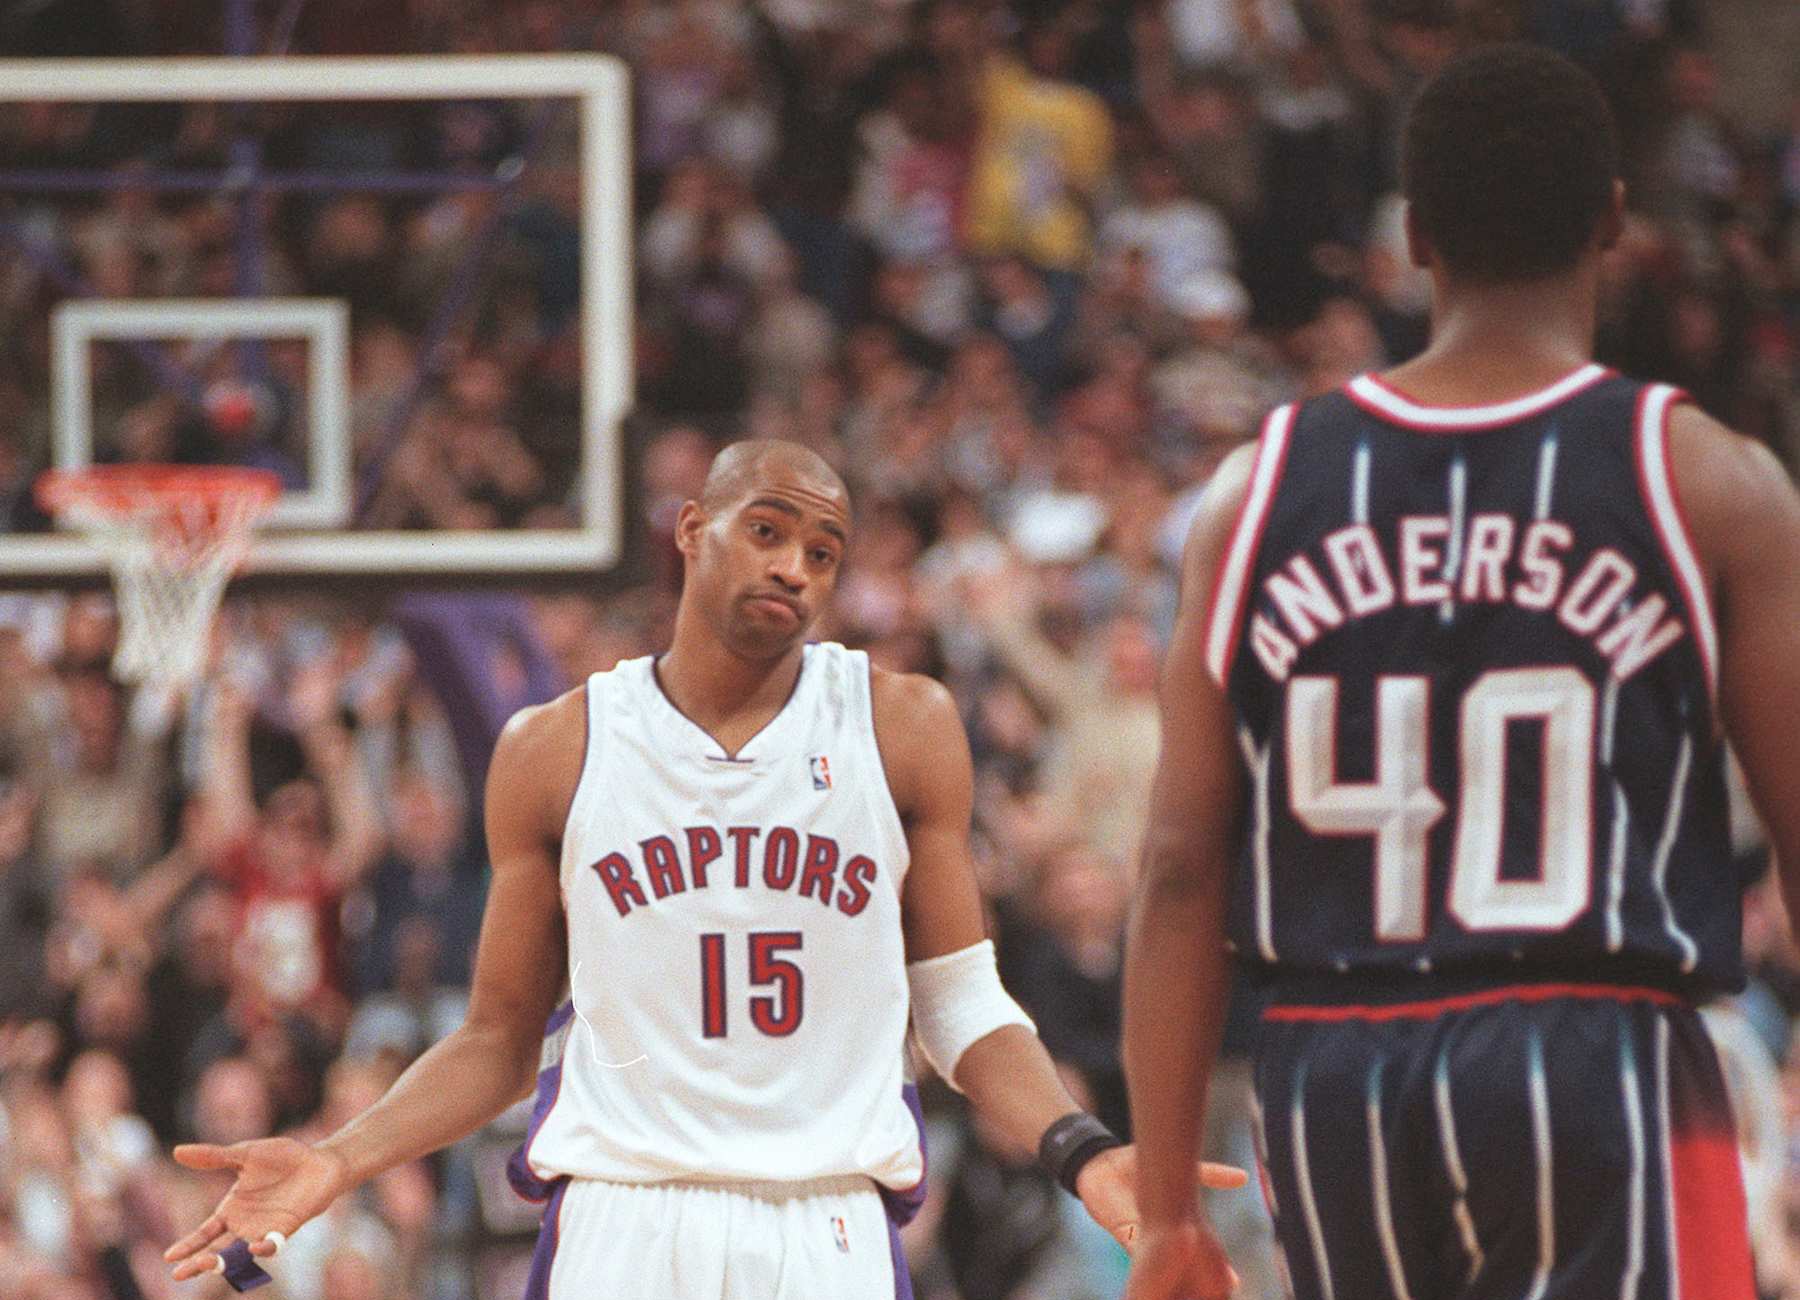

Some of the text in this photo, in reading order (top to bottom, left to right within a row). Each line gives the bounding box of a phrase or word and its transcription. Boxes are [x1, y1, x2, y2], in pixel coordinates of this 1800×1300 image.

[1249, 514, 1685, 683] ANDERSON
[591, 826, 877, 917] RAPTORS
[1286, 665, 1596, 943] 40
[699, 931, 804, 1038] 15
